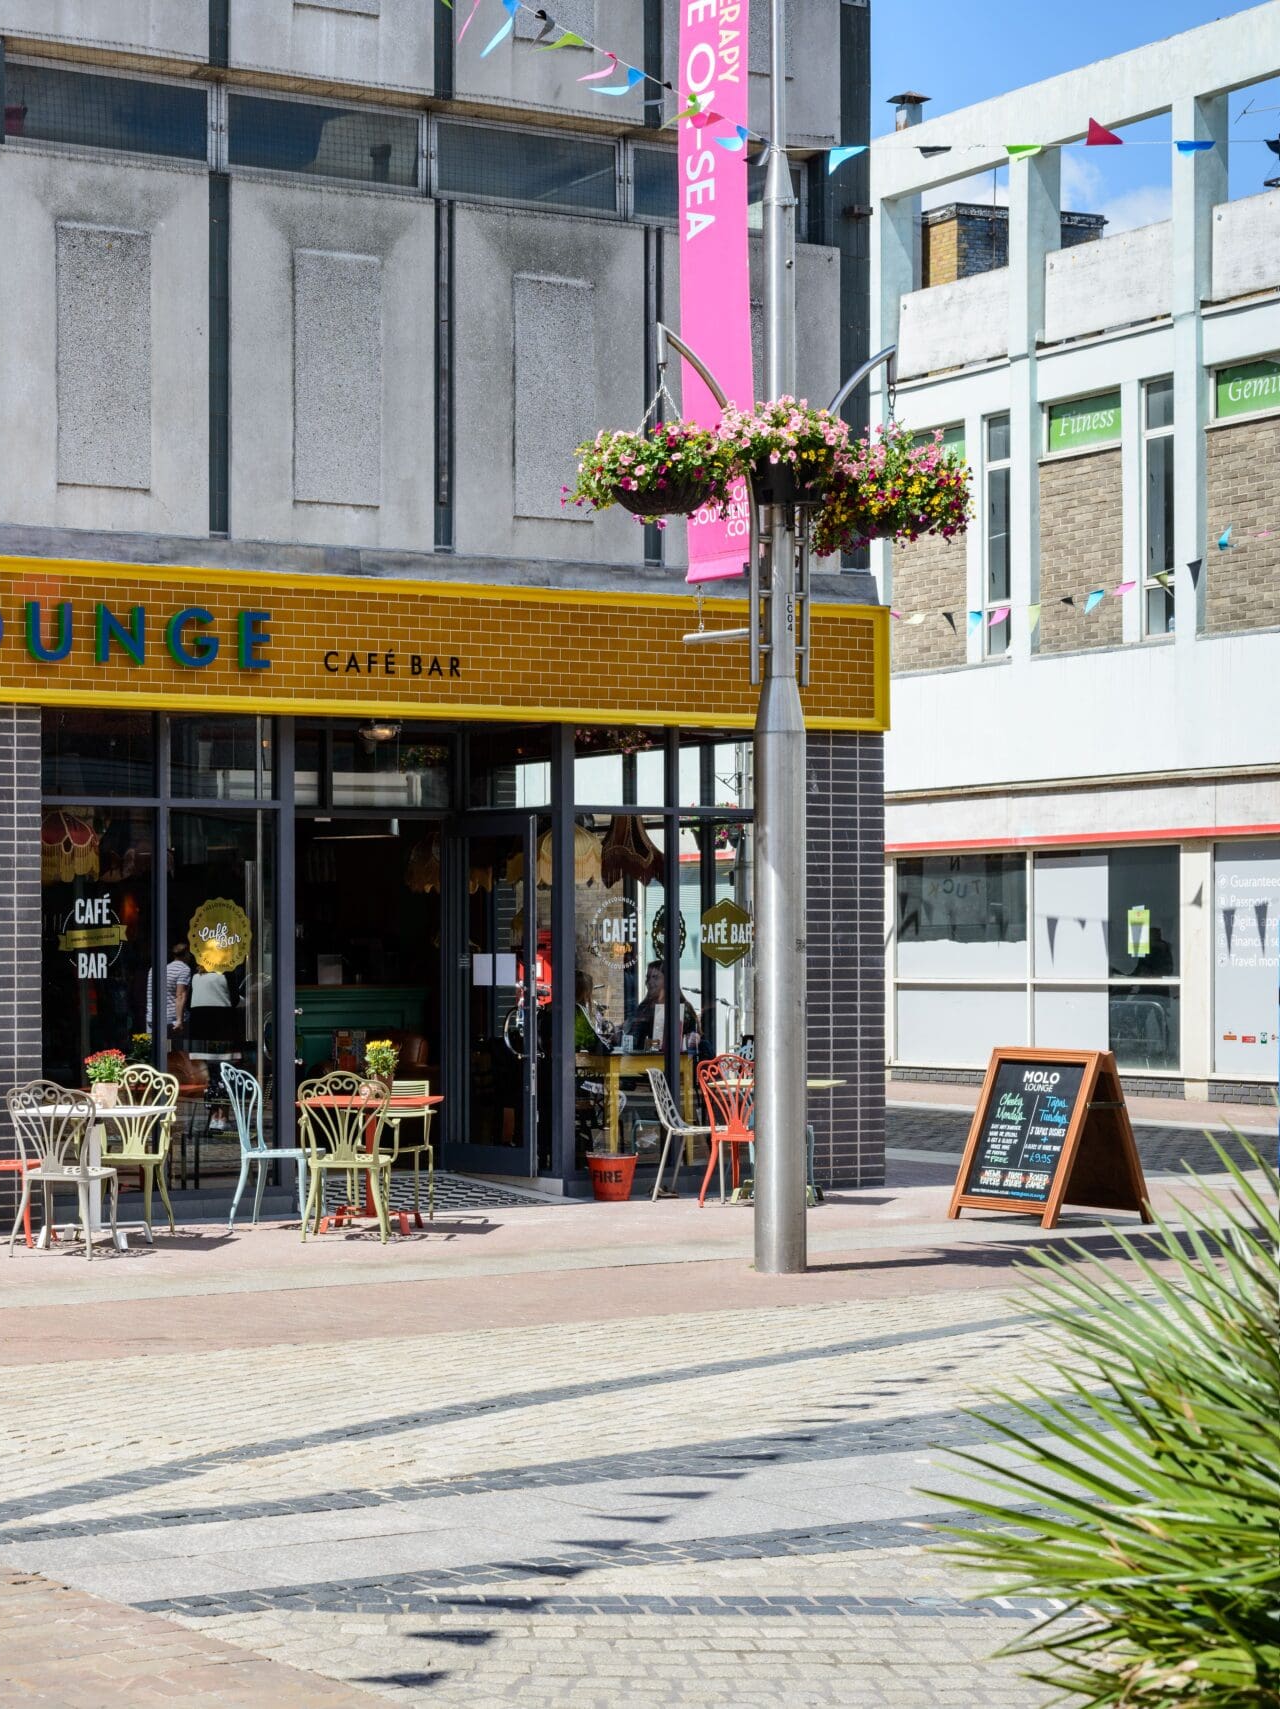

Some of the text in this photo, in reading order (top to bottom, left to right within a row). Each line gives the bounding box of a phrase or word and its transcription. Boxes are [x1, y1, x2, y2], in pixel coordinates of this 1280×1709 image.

[1229, 368, 1280, 401] Gemi
[1059, 411, 1115, 436] Fitness
[692, 502, 750, 526] SOUTEND
[324, 649, 461, 677] CAFÉ BAR
[75, 893, 111, 925] CAFÉ
[1230, 895, 1273, 911] Passports
[199, 922, 228, 943] Café
[603, 912, 637, 943] CAFÉ
[701, 918, 727, 944] CAFÉ
[217, 934, 242, 949] Bar
[78, 953, 107, 978] BAR
[1230, 953, 1257, 967] Travel
[1023, 1071, 1060, 1084] MOLO
[1024, 1083, 1054, 1093] LOUNGE
[1029, 1152, 1054, 1164] £9.95
[592, 1170, 623, 1183] FIRE
